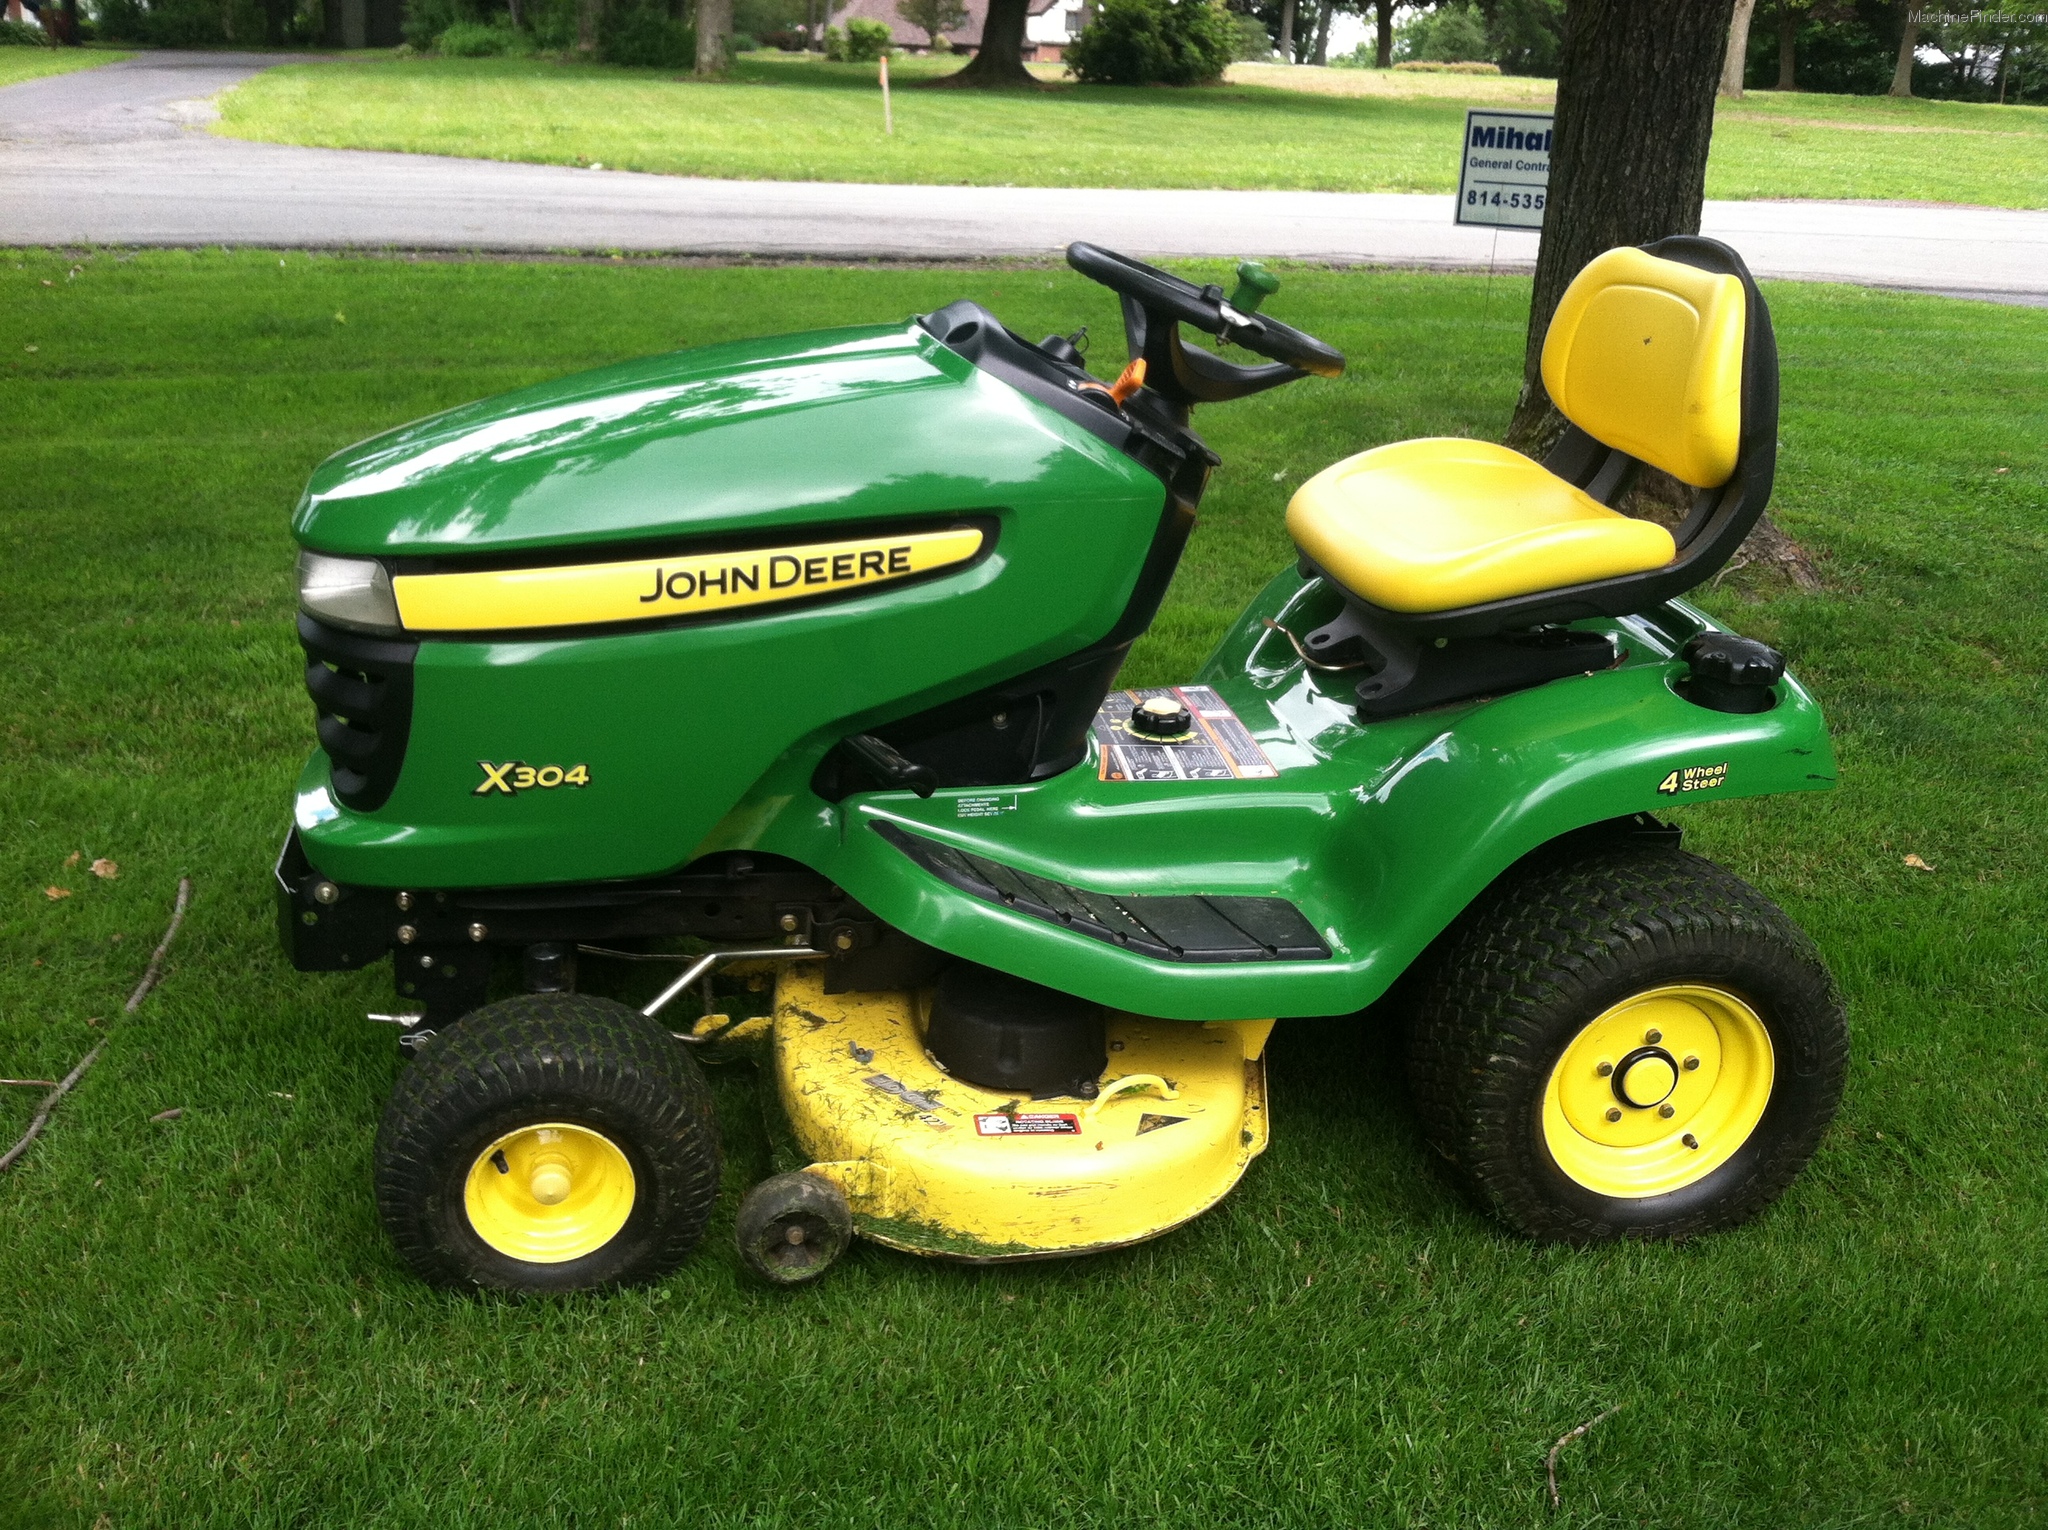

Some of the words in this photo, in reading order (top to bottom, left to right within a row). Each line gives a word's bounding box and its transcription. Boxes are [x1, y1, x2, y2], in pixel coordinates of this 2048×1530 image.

[1470, 157, 1512, 170] General
[1467, 190, 1545, 210] 814-535
[639, 564, 760, 603] JOHN
[769, 545, 912, 590] DEERE
[474, 761, 590, 793] X304
[1658, 770, 1679, 794] 4
[1683, 762, 1728, 780] Wheel
[1681, 776, 1725, 791] Steer
